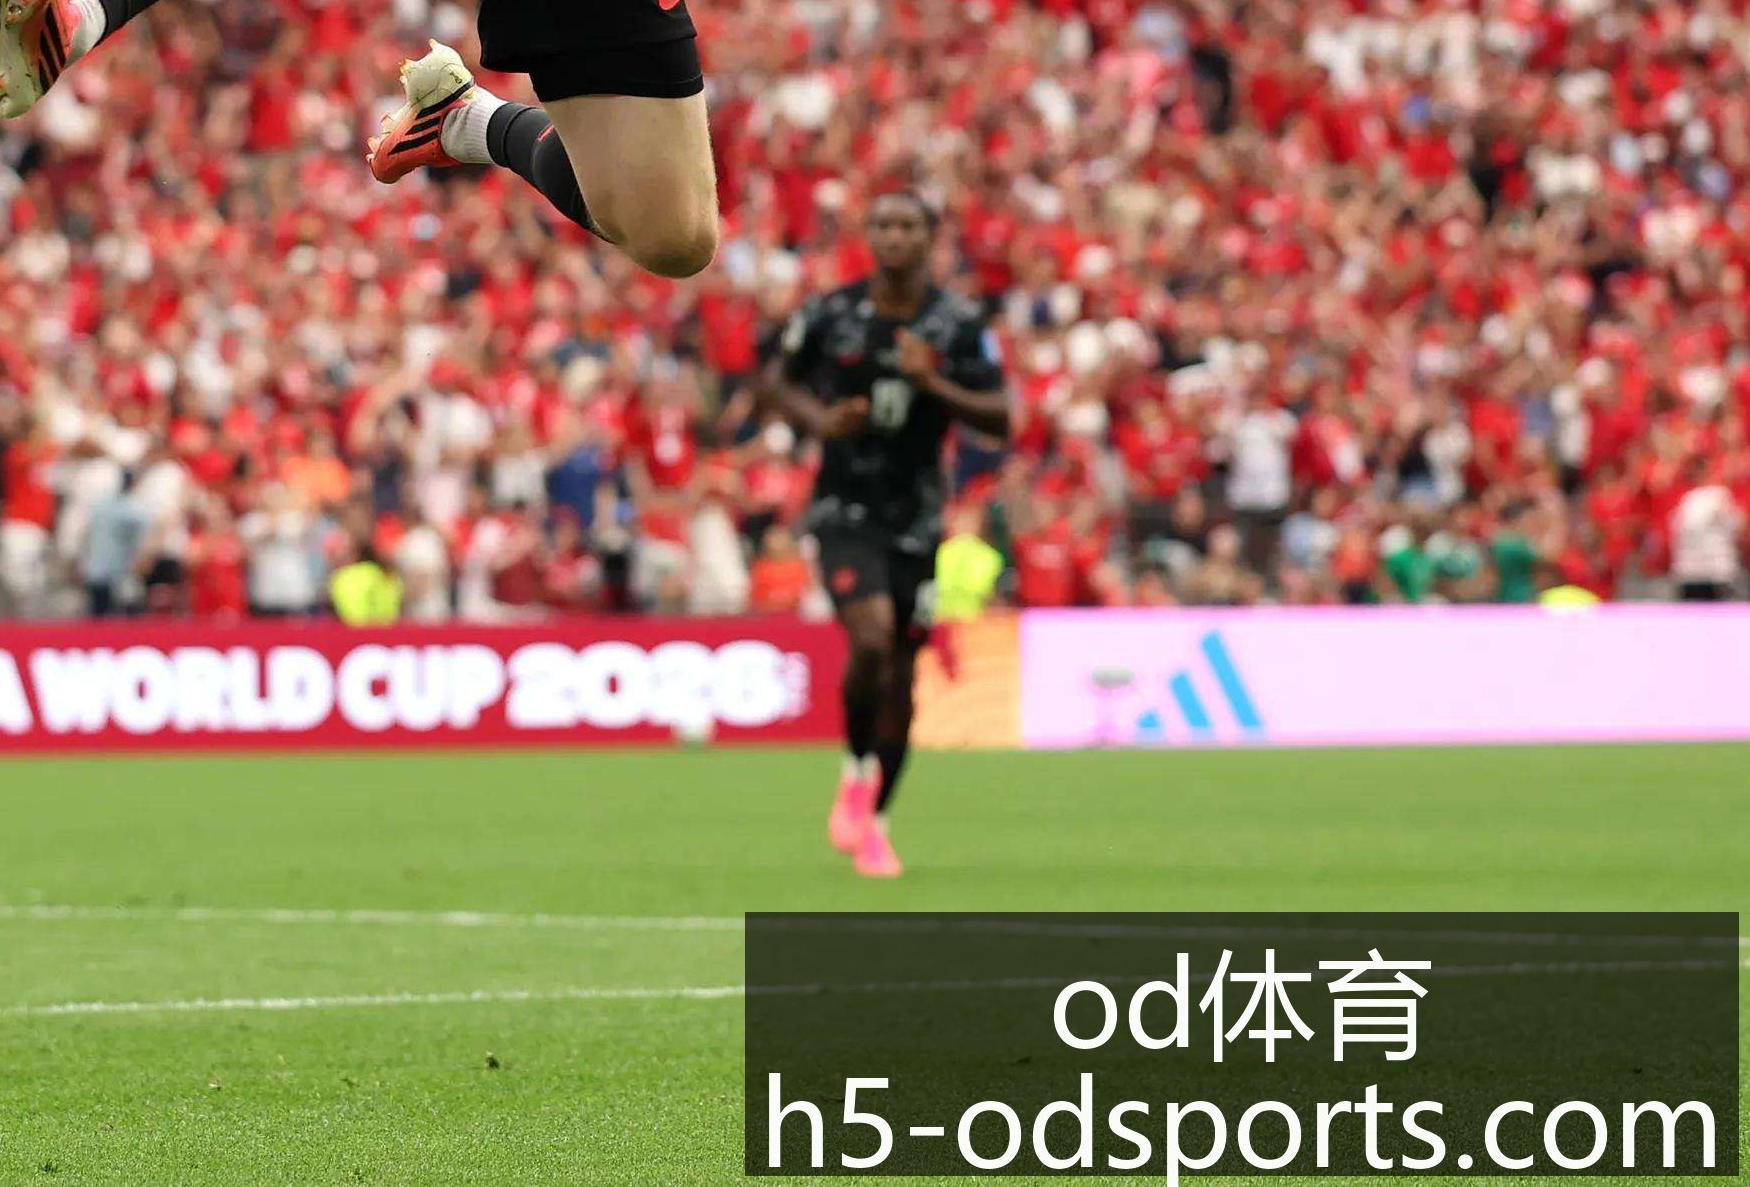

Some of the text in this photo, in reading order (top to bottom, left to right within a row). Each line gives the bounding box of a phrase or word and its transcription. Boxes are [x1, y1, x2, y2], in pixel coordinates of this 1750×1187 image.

[31, 645, 335, 733] WORLD
[337, 643, 505, 731] CUP
[504, 639, 786, 728] 2026
